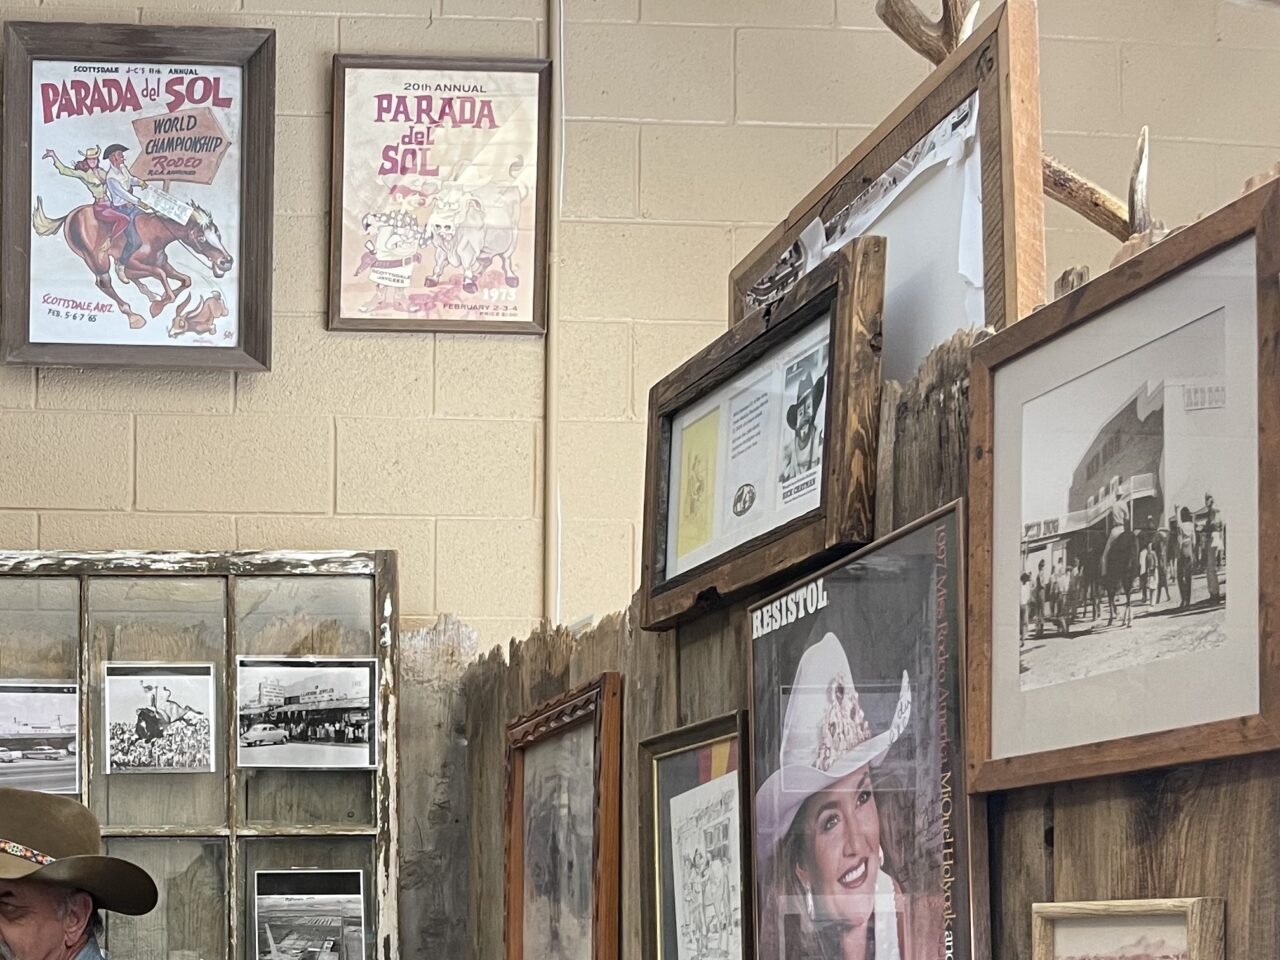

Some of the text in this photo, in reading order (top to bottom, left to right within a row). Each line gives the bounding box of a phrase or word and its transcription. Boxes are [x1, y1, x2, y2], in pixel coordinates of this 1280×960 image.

[74, 66, 120, 74] SCOTTSDALE
[168, 68, 199, 76] ANNUAL
[404, 82, 487, 94] 20th ANNUAL
[40, 76, 233, 124] PARADA del SOL
[374, 94, 500, 130] PARADA
[154, 115, 198, 134] WORLD
[146, 136, 223, 155] CHAMPIONSHIP
[378, 142, 440, 177] SOL
[151, 156, 202, 171] RODEO
[752, 578, 827, 640] RESISTOL
[935, 574, 948, 619] Miss
[936, 622, 950, 683] Rodeo
